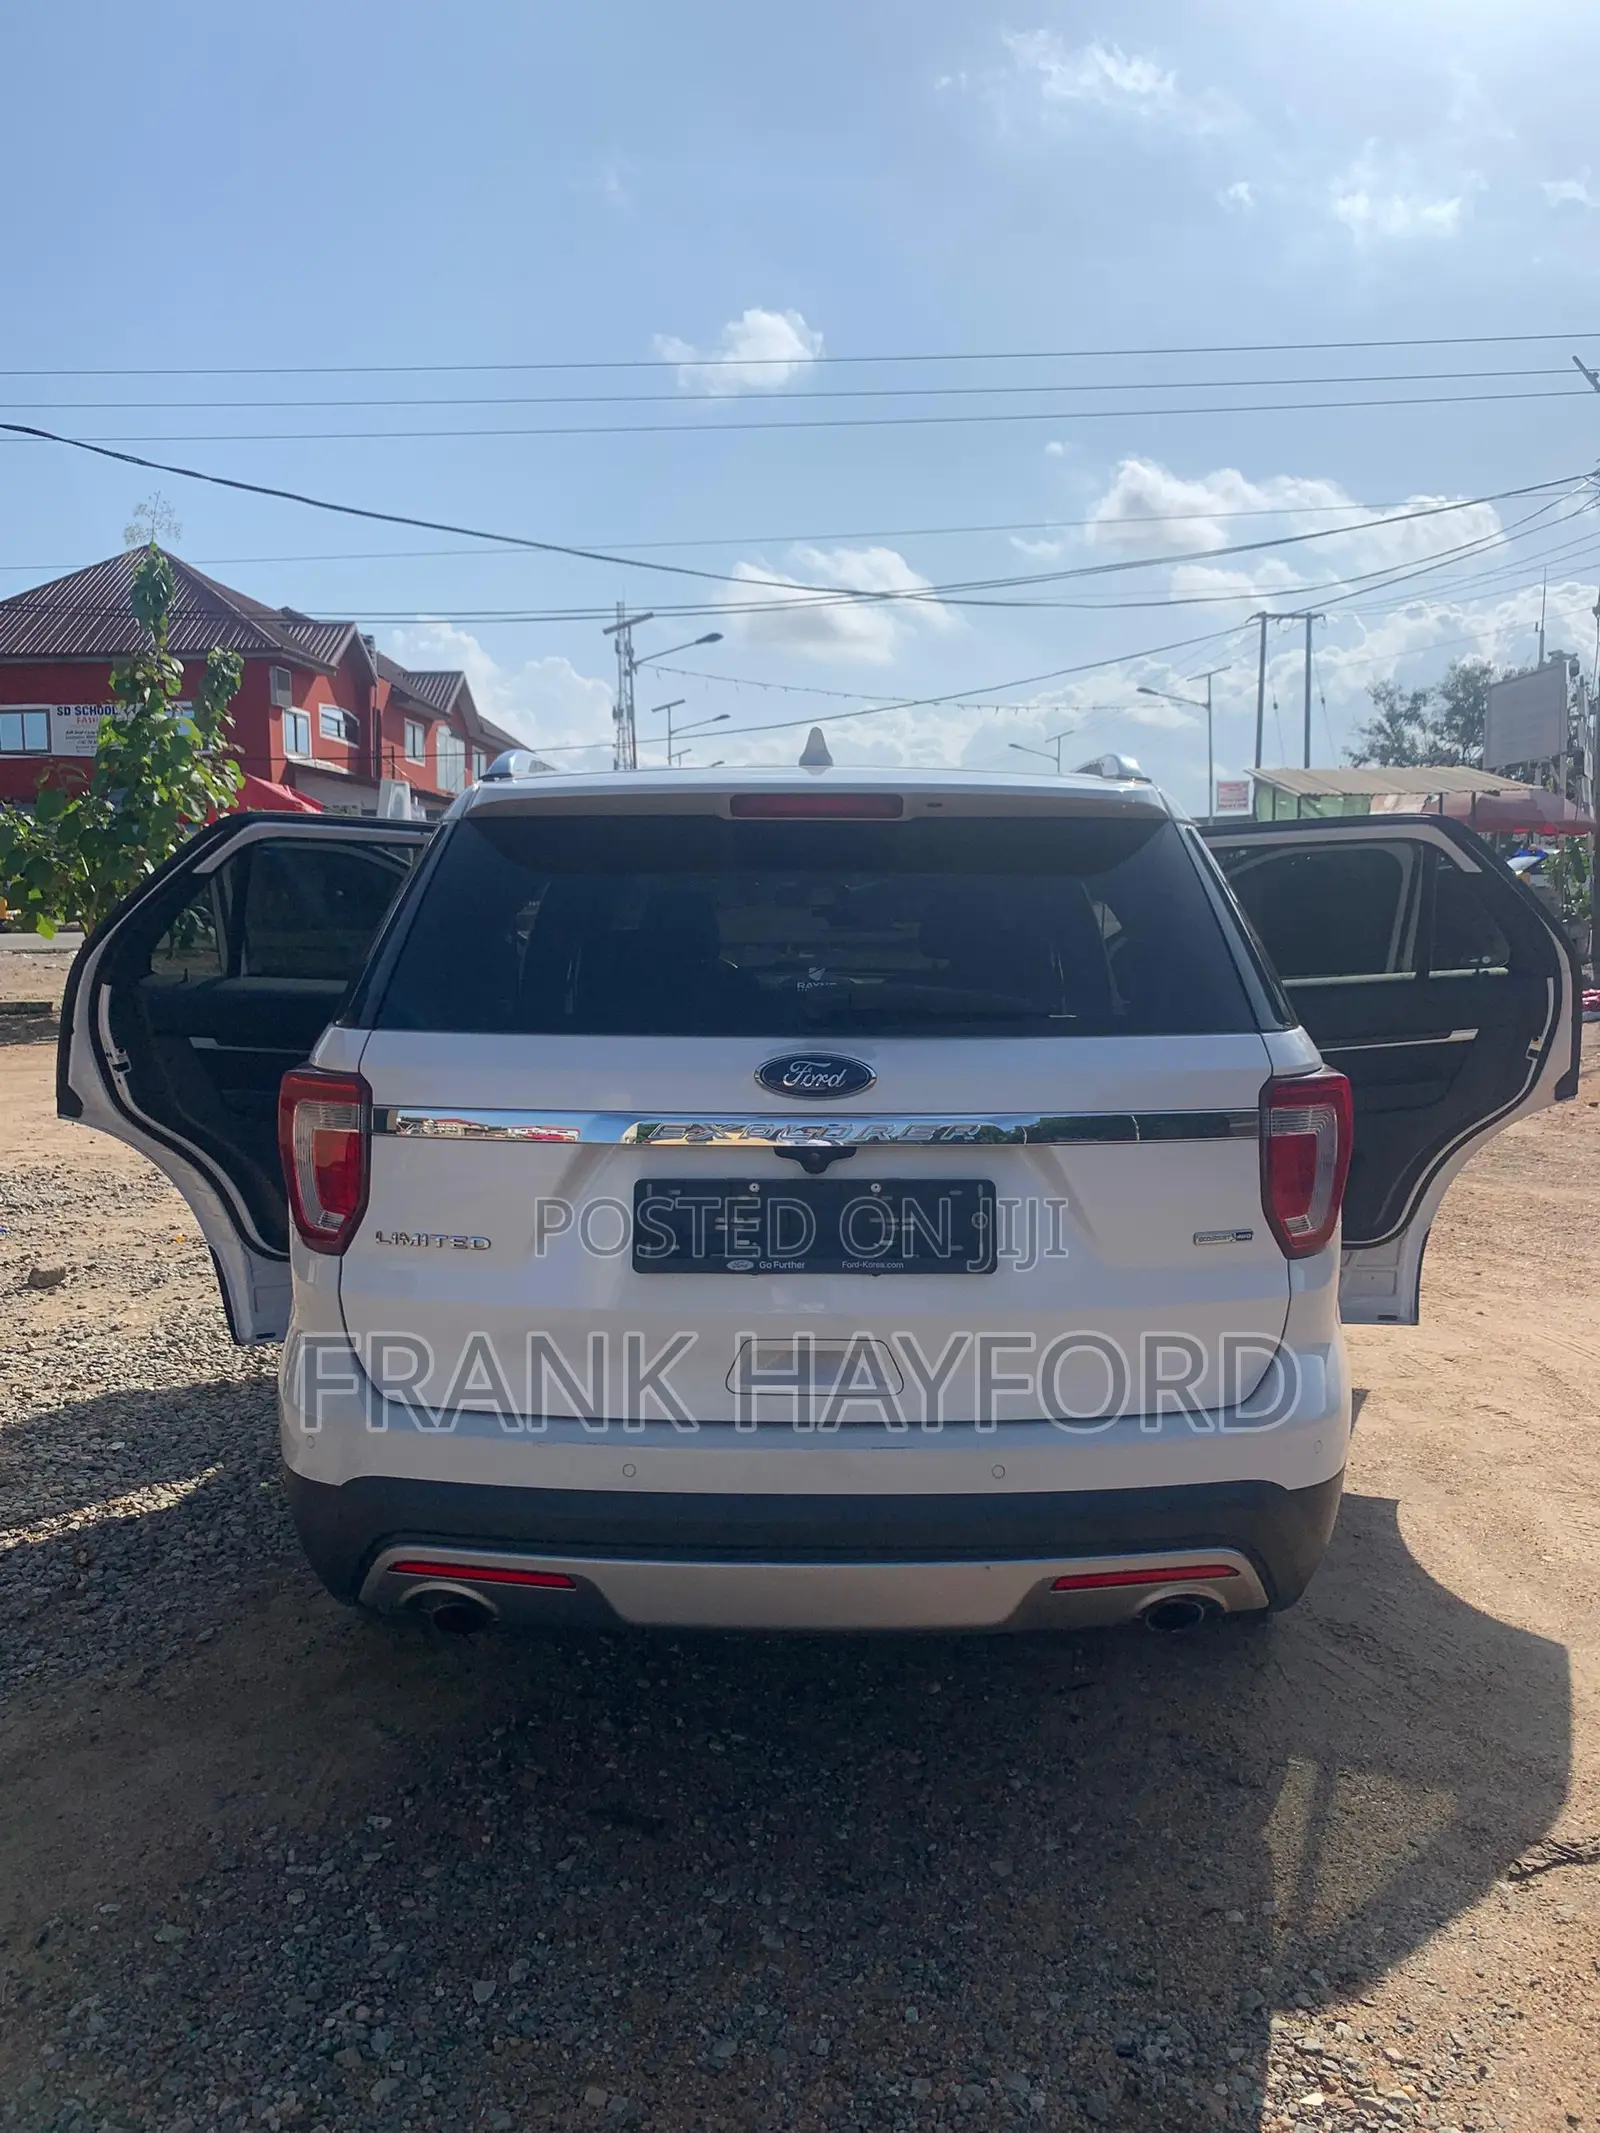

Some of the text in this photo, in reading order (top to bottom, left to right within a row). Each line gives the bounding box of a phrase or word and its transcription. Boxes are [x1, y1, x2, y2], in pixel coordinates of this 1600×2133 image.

[56, 705, 118, 716] SD SCHOOL
[782, 1060, 849, 1088] Ford
[648, 1122, 983, 1142] EXPLORER
[375, 1230, 492, 1250] LIMITED
[758, 1260, 806, 1269] Go Further
[841, 1260, 904, 1269] Ford-Korea.com
